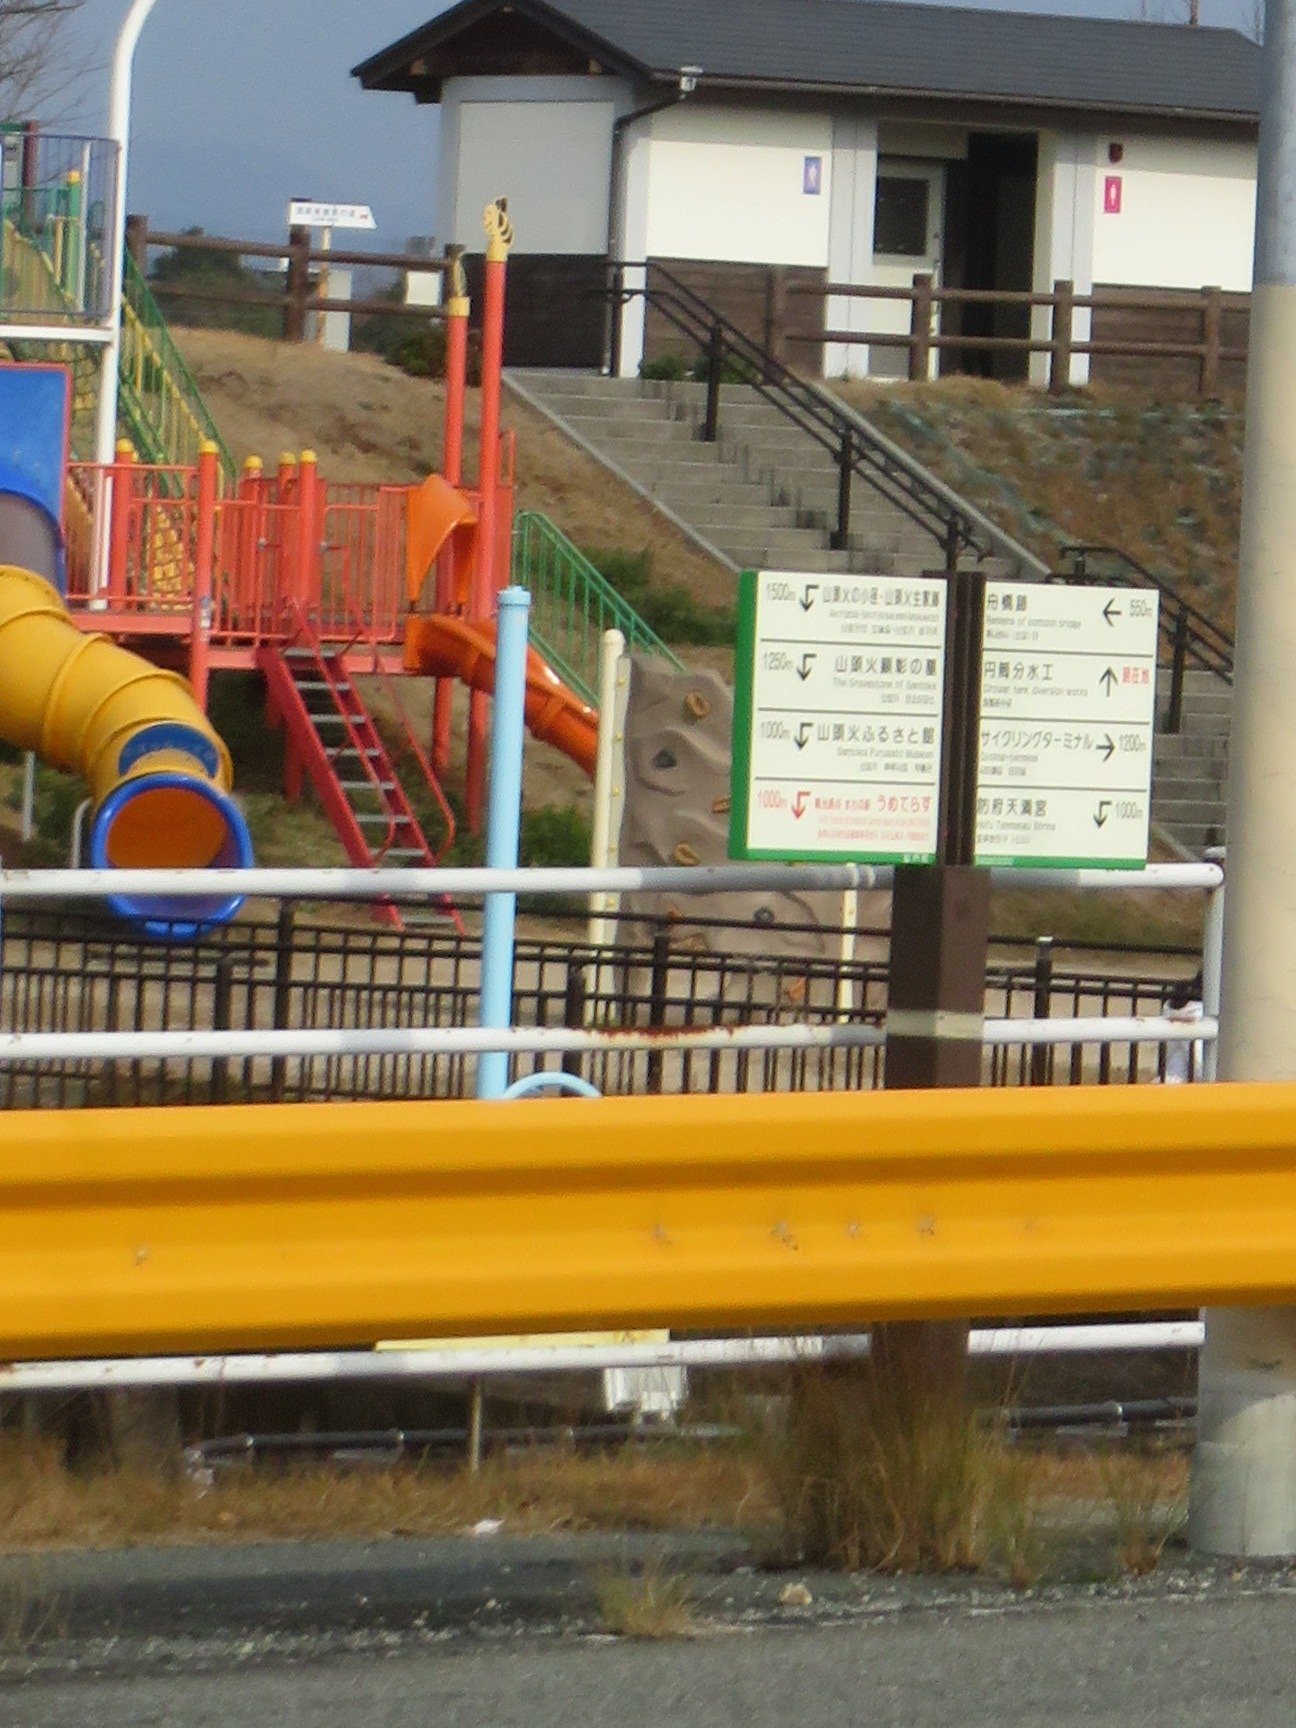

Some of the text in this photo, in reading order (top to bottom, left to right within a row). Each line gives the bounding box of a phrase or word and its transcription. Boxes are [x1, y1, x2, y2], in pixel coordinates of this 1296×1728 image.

[766, 583, 795, 601] 1500m
[1122, 666, 1150, 684] 現在地
[761, 722, 789, 739] 1000m
[817, 723, 935, 744] 山頭火ふるさと館
